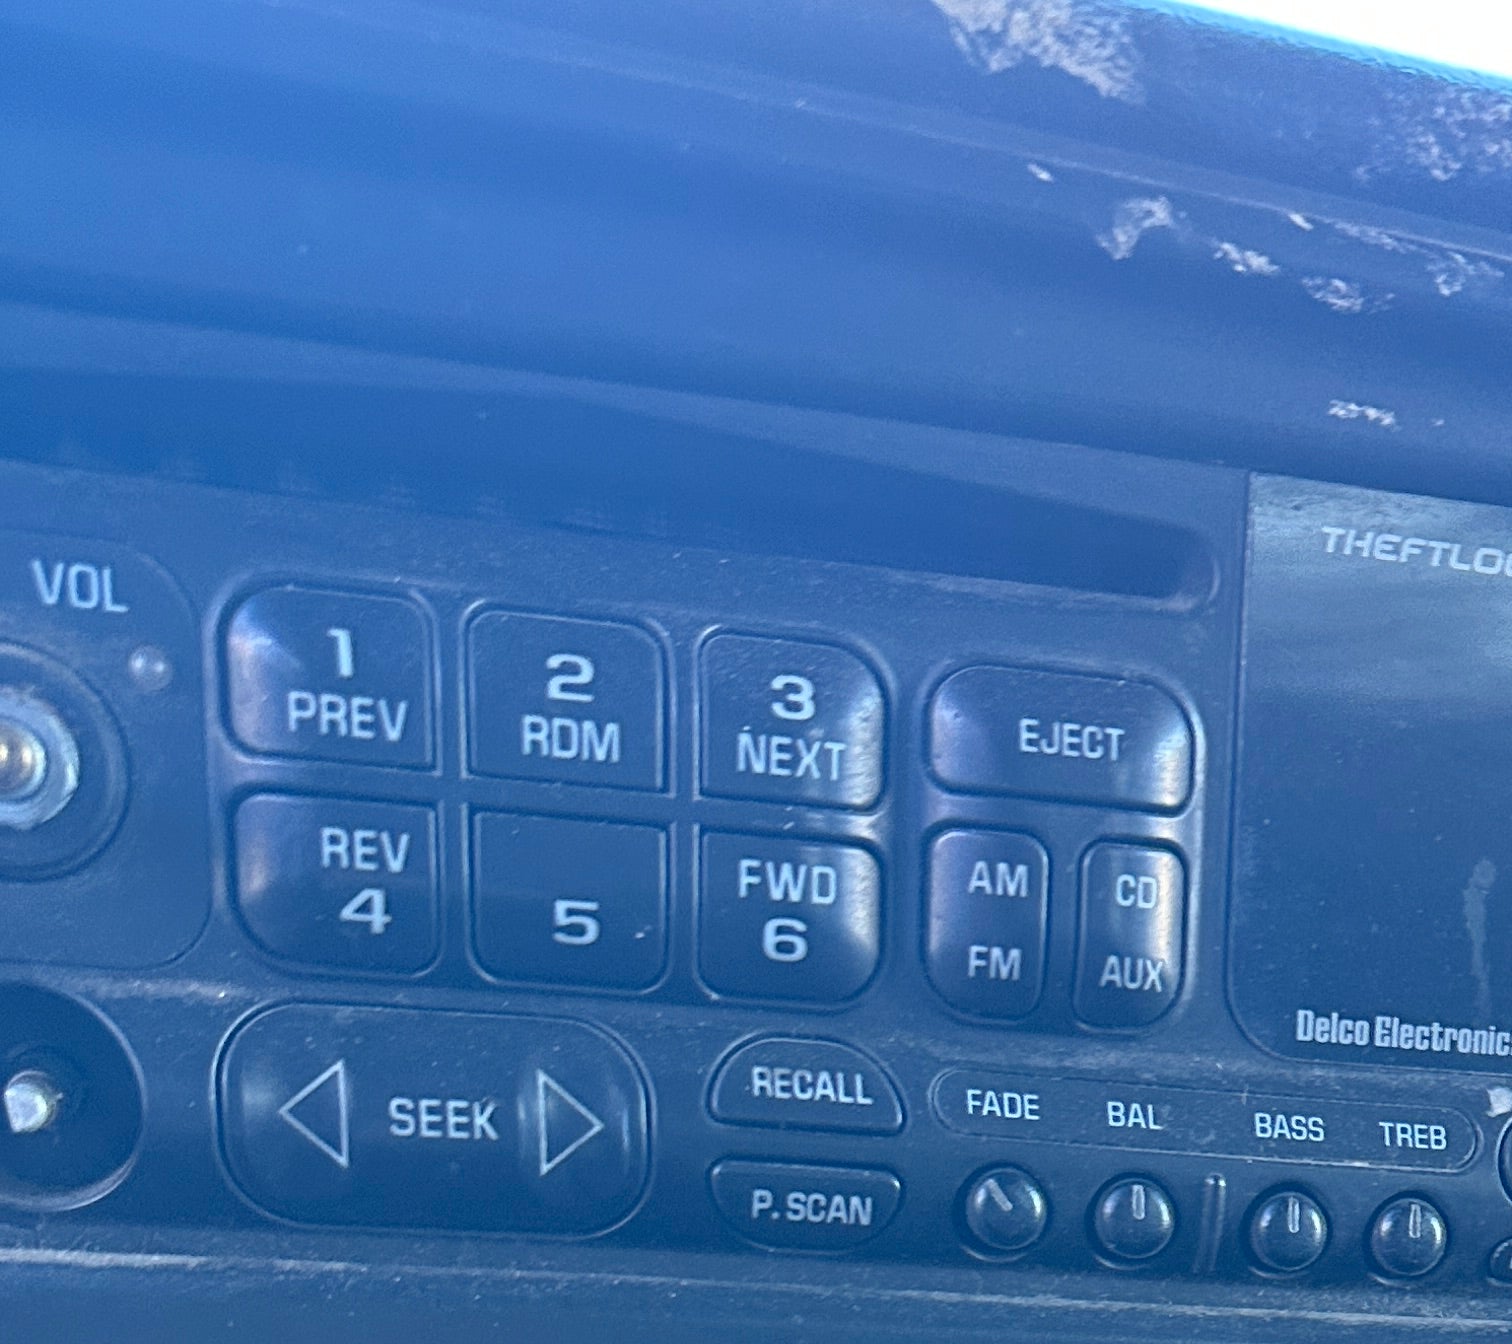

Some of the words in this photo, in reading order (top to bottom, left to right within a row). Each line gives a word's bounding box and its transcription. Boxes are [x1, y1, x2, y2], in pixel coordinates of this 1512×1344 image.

[32, 560, 129, 614] VOL
[328, 629, 355, 678] 1
[546, 654, 594, 702] 2
[771, 675, 815, 721] 3
[288, 691, 407, 742] PREV
[521, 715, 620, 763] RDM
[737, 733, 845, 781] NEXT
[1019, 719, 1125, 763] EJECT
[321, 829, 409, 873] REV
[739, 859, 837, 904] FWD
[969, 862, 1028, 898] AM
[1115, 873, 1158, 910] CD
[339, 889, 392, 935] 4
[554, 900, 600, 945] 5
[762, 917, 808, 963] 6
[969, 945, 1021, 981] FM
[1101, 955, 1164, 993] AUX
[1297, 1009, 1370, 1046] Delco
[752, 1065, 873, 1105] RECALL
[389, 1098, 499, 1141] SEEK
[967, 1090, 1040, 1121] FADE
[1108, 1100, 1163, 1131] BAL
[1254, 1112, 1325, 1143] BASS
[1380, 1122, 1447, 1152] TREB
